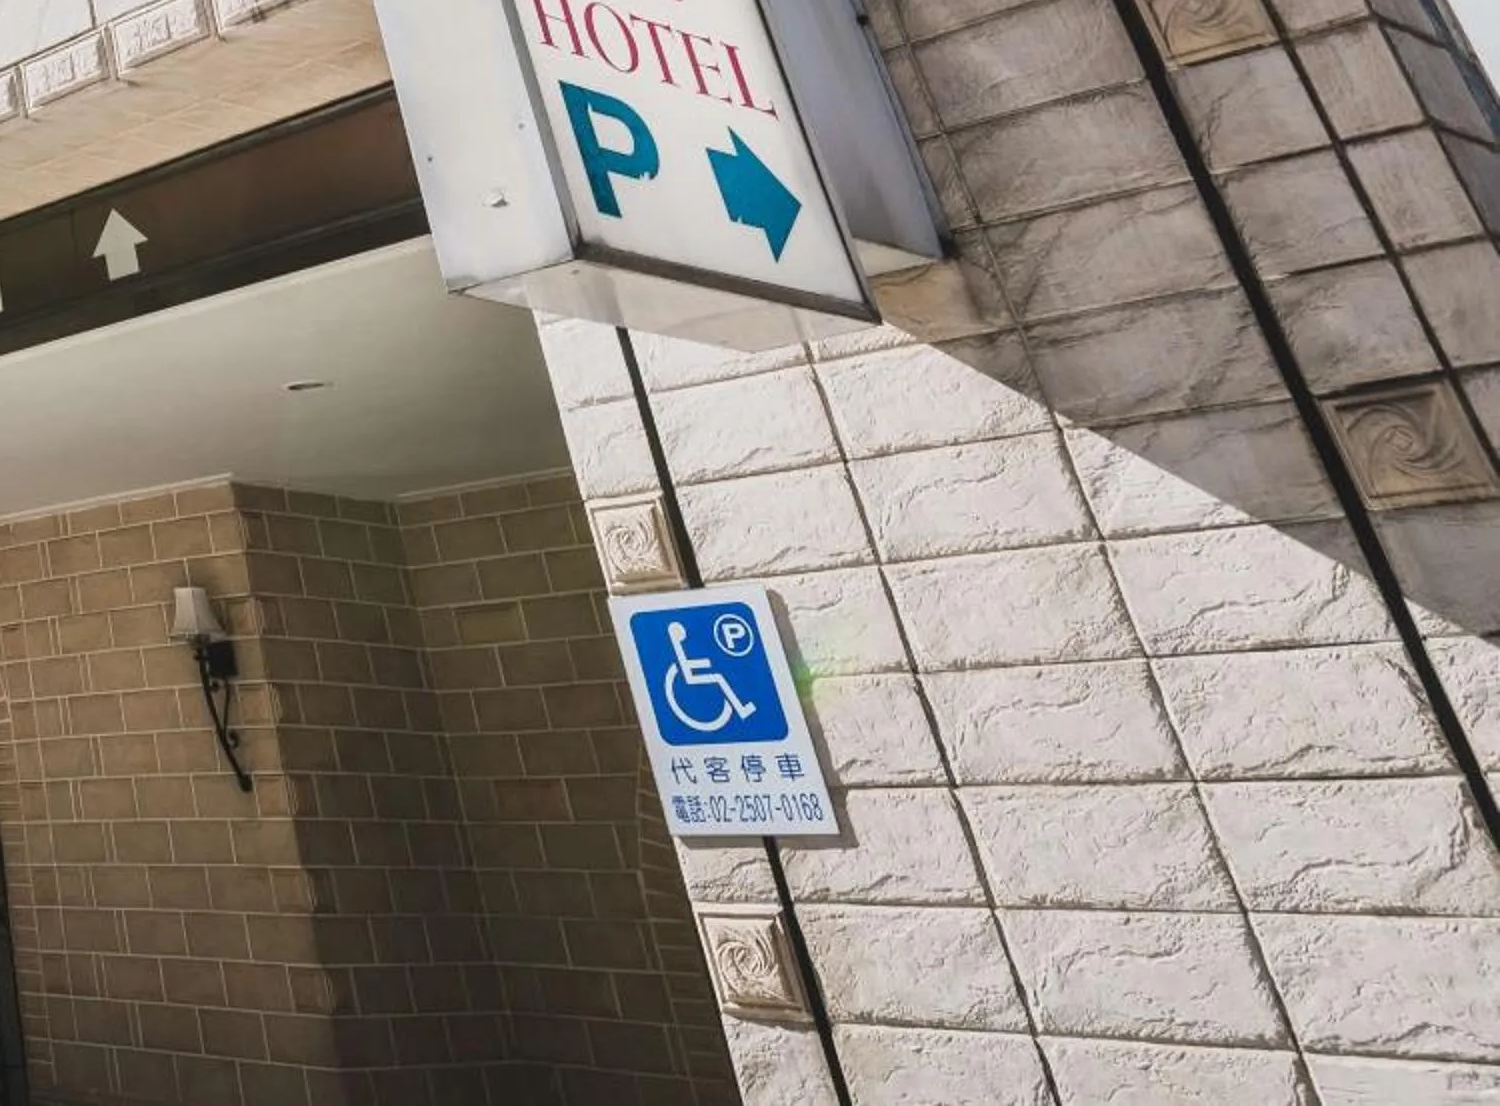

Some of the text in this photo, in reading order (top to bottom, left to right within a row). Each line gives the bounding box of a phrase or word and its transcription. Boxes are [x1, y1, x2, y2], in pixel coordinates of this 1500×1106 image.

[559, 79, 660, 219] P
[671, 752, 805, 785] 代客停車
